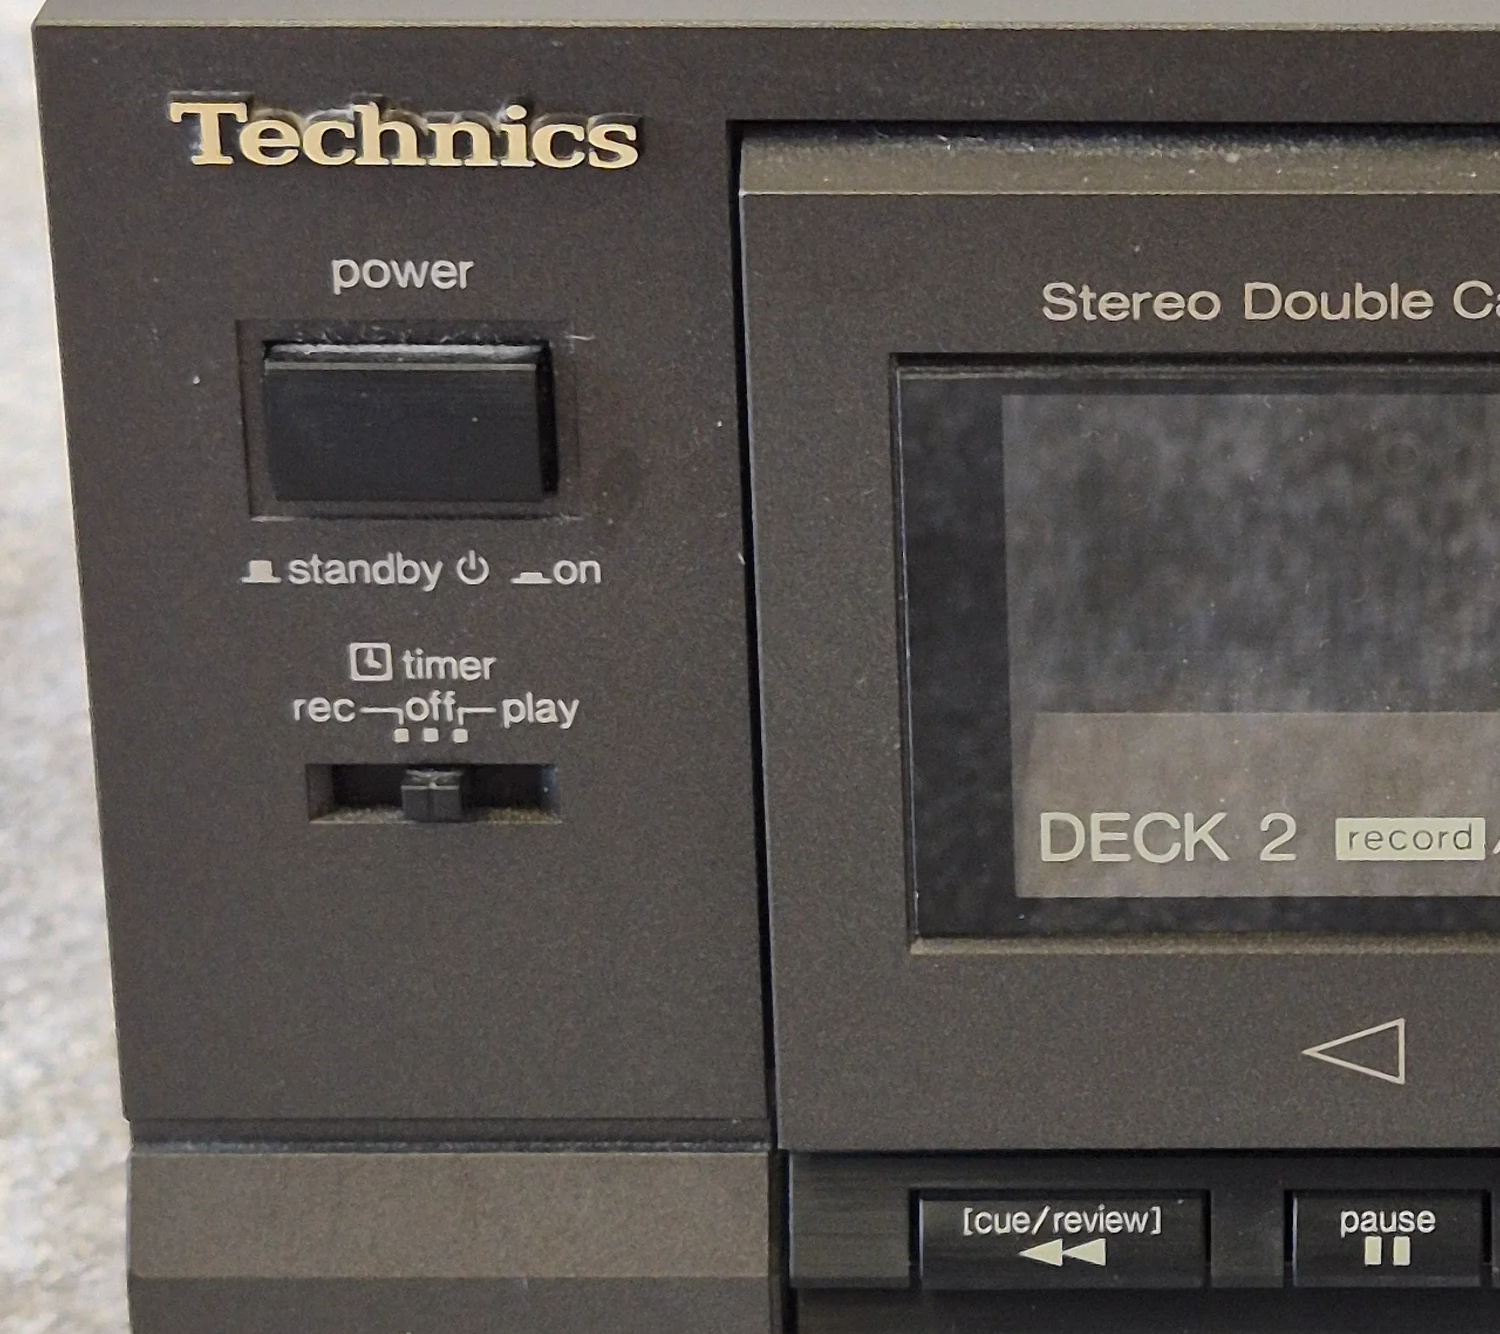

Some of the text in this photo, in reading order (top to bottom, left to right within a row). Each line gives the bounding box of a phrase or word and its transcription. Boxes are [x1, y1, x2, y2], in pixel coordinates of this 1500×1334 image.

[168, 101, 639, 169] Technics
[331, 259, 474, 296] power
[1042, 281, 1221, 321] Stereo
[1244, 281, 1434, 321] Double
[288, 551, 602, 592] standby on
[401, 648, 497, 681] timer
[293, 689, 580, 730] rec off play
[1040, 811, 1230, 864] DECK
[1259, 812, 1297, 862] 2
[1349, 823, 1472, 851] record
[963, 1204, 1161, 1236] [cue/review]
[1340, 1210, 1436, 1238] pause
